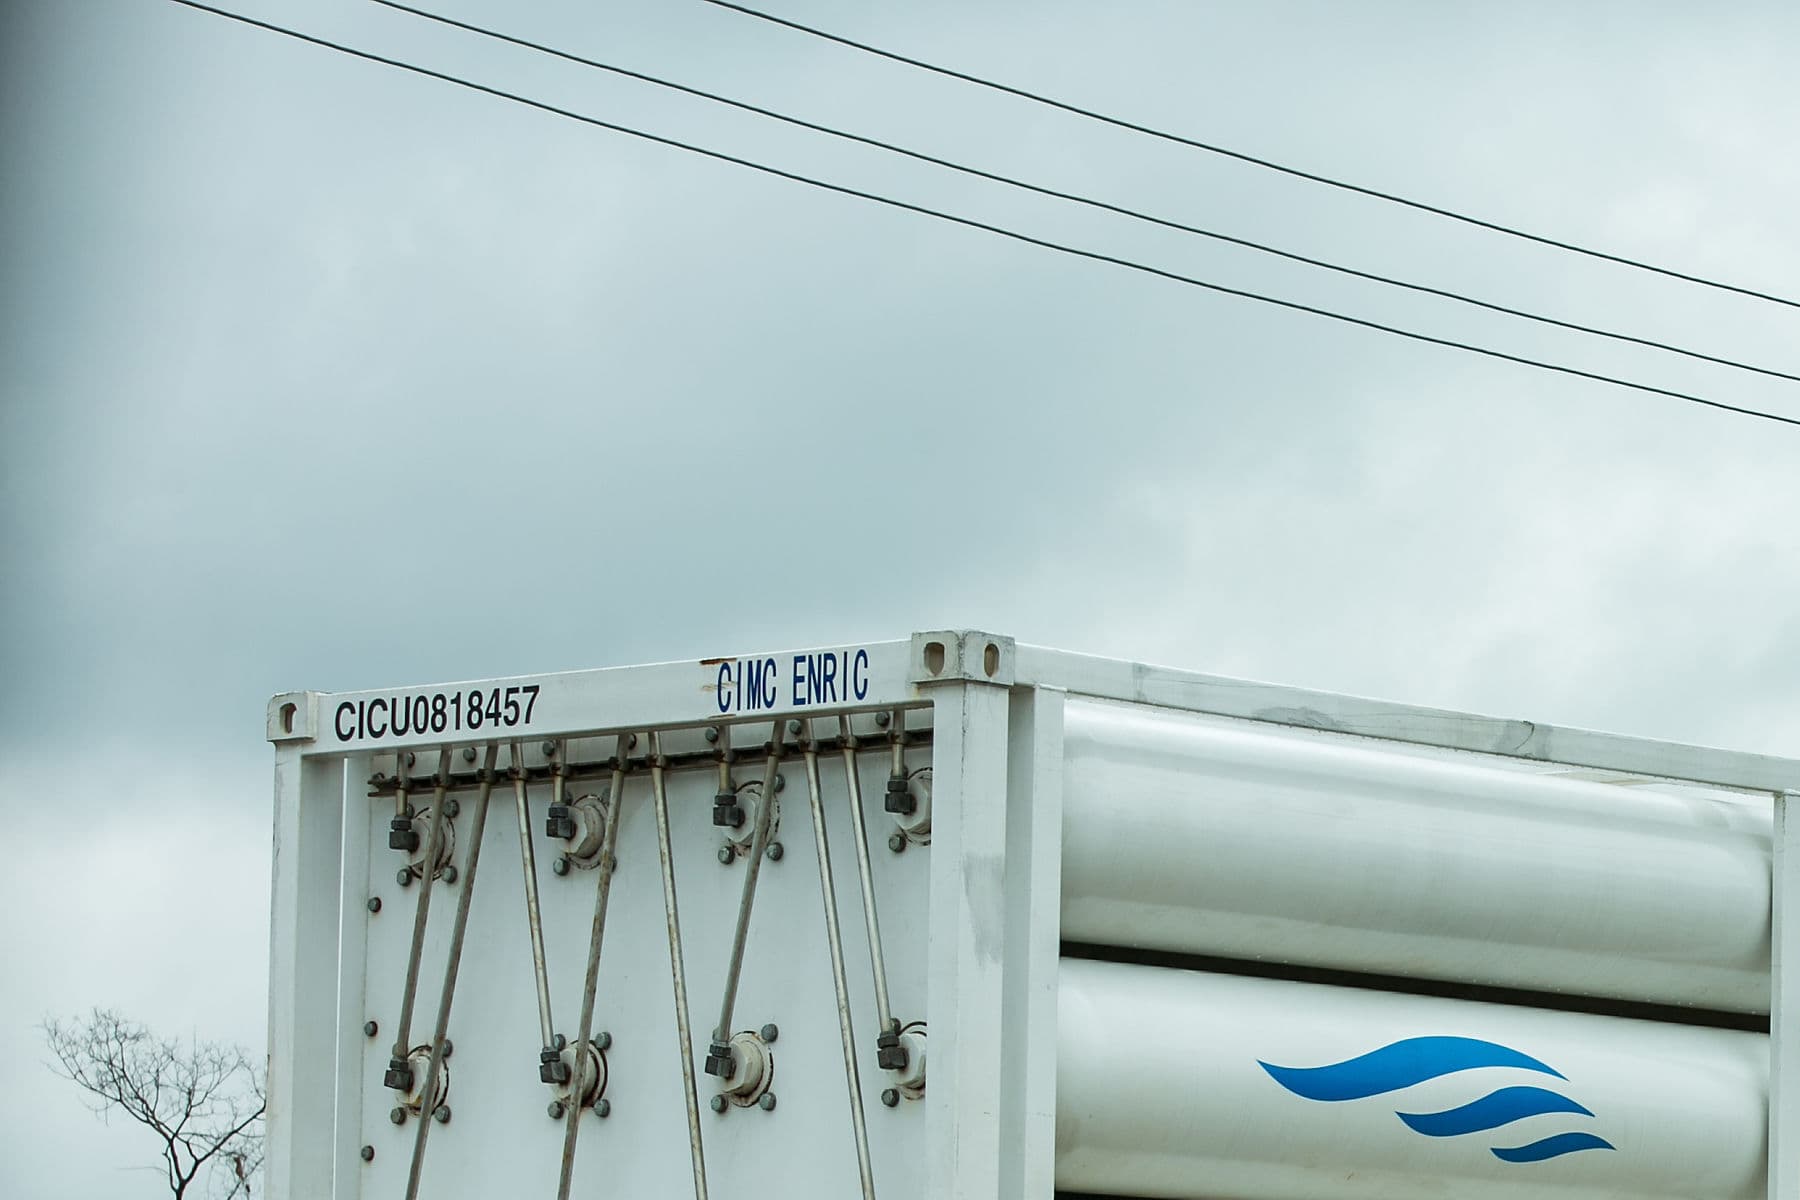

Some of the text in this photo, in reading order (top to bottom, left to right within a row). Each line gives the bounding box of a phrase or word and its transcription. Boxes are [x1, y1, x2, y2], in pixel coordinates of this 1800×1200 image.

[717, 649, 869, 713] CIMC ENRIC
[334, 684, 541, 742] CICU0818457
